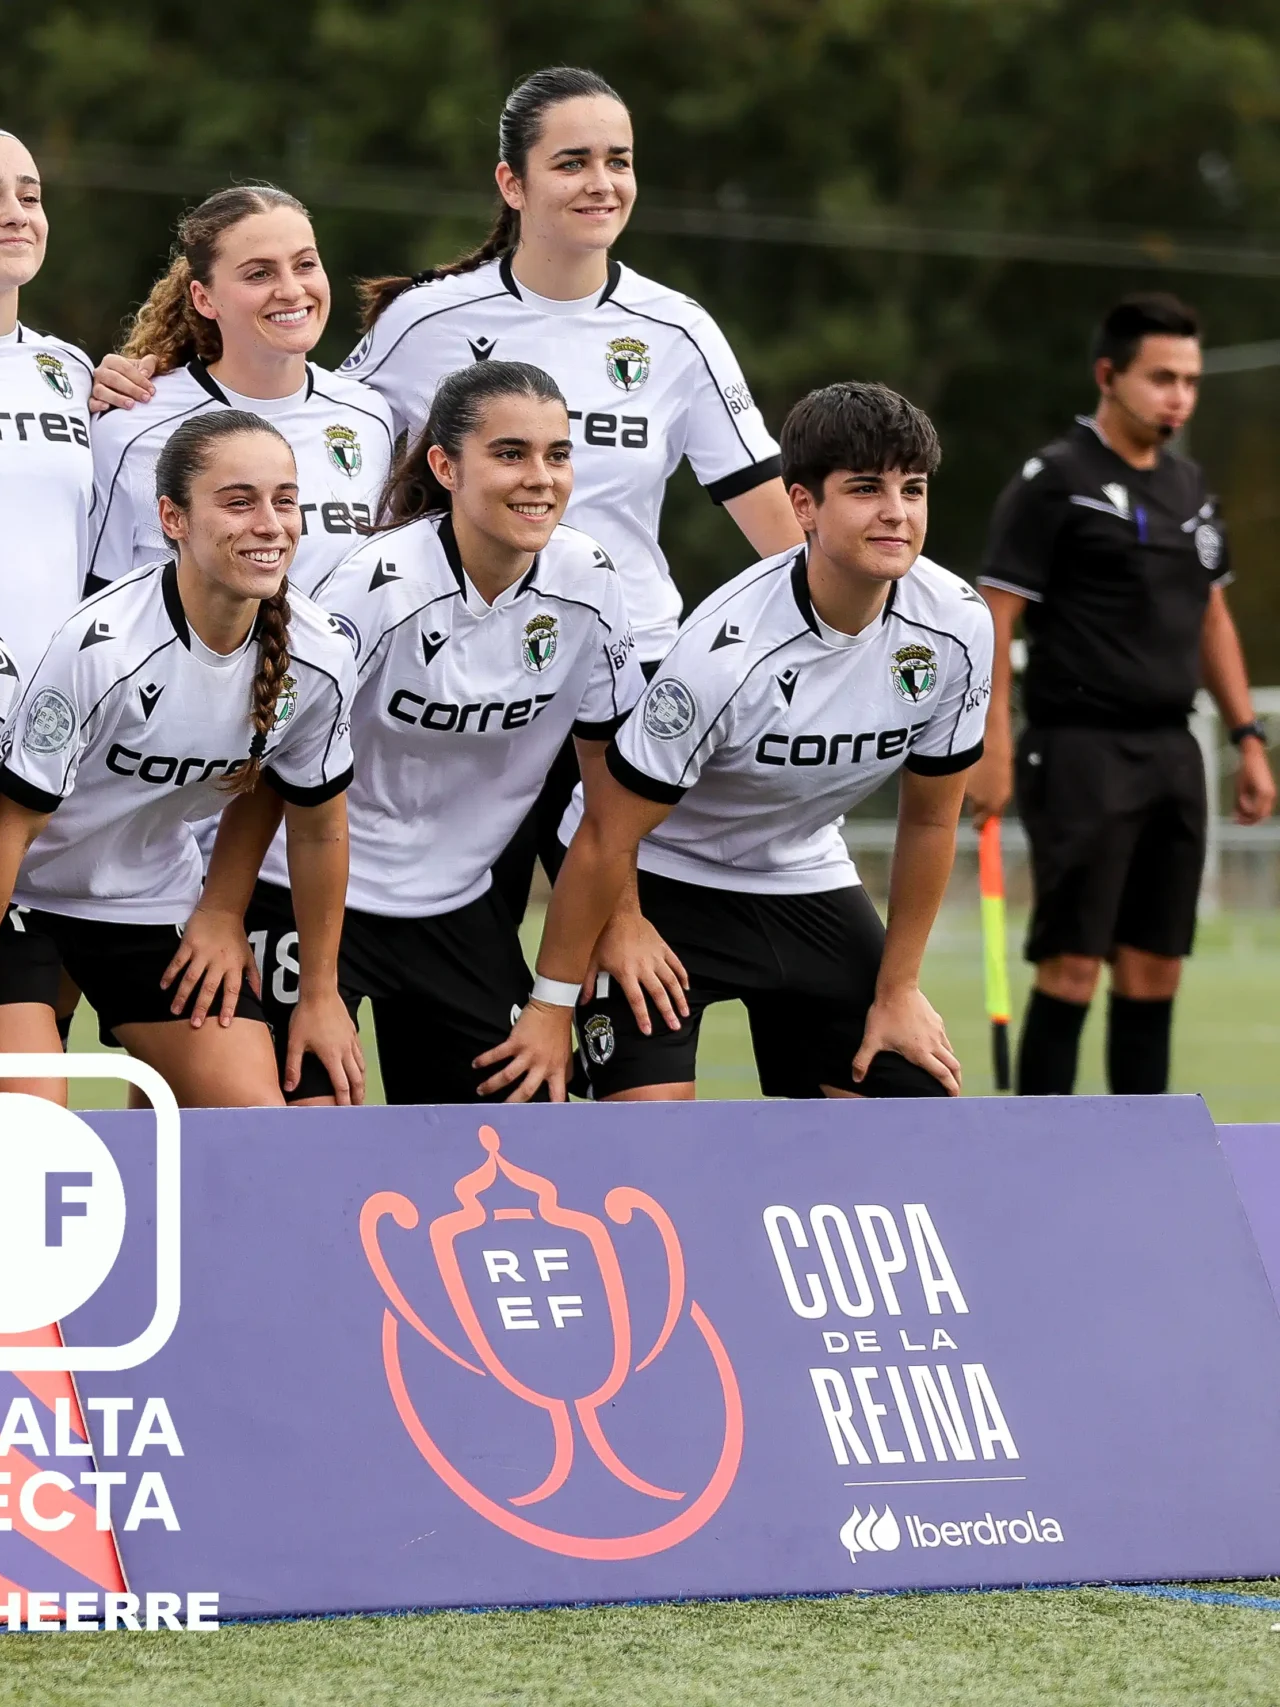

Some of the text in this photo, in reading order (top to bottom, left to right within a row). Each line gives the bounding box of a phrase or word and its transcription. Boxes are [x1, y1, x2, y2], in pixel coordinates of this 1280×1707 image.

[763, 1203, 970, 1319] COPA
[822, 1328, 958, 1353] DE LA
[809, 1363, 1020, 1465] REINA
[905, 1511, 1064, 1548] Iberdrola
